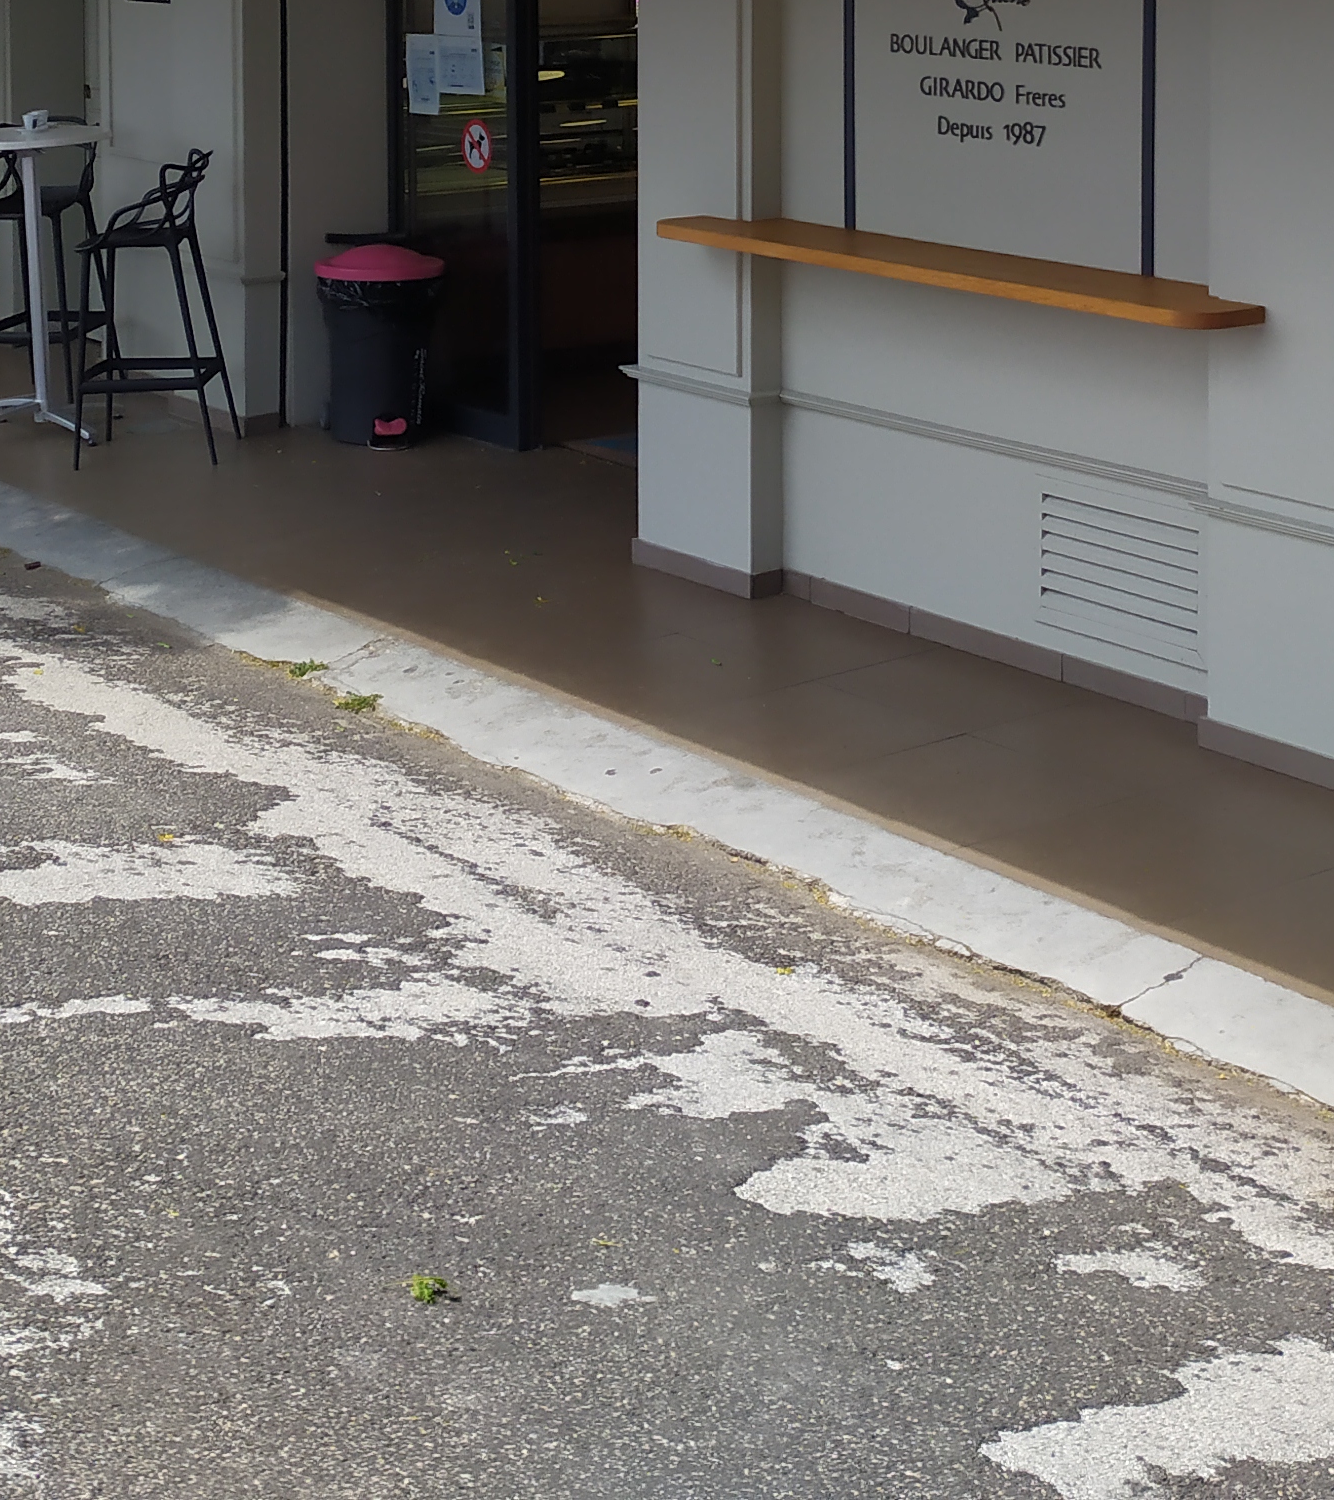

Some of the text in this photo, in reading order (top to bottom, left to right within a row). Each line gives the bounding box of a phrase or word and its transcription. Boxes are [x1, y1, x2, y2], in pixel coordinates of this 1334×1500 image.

[889, 33, 1103, 70] BOULANGER PATISSIER
[919, 75, 1066, 108] GIRARDO Freres
[937, 116, 1047, 147] Depuis 1987
